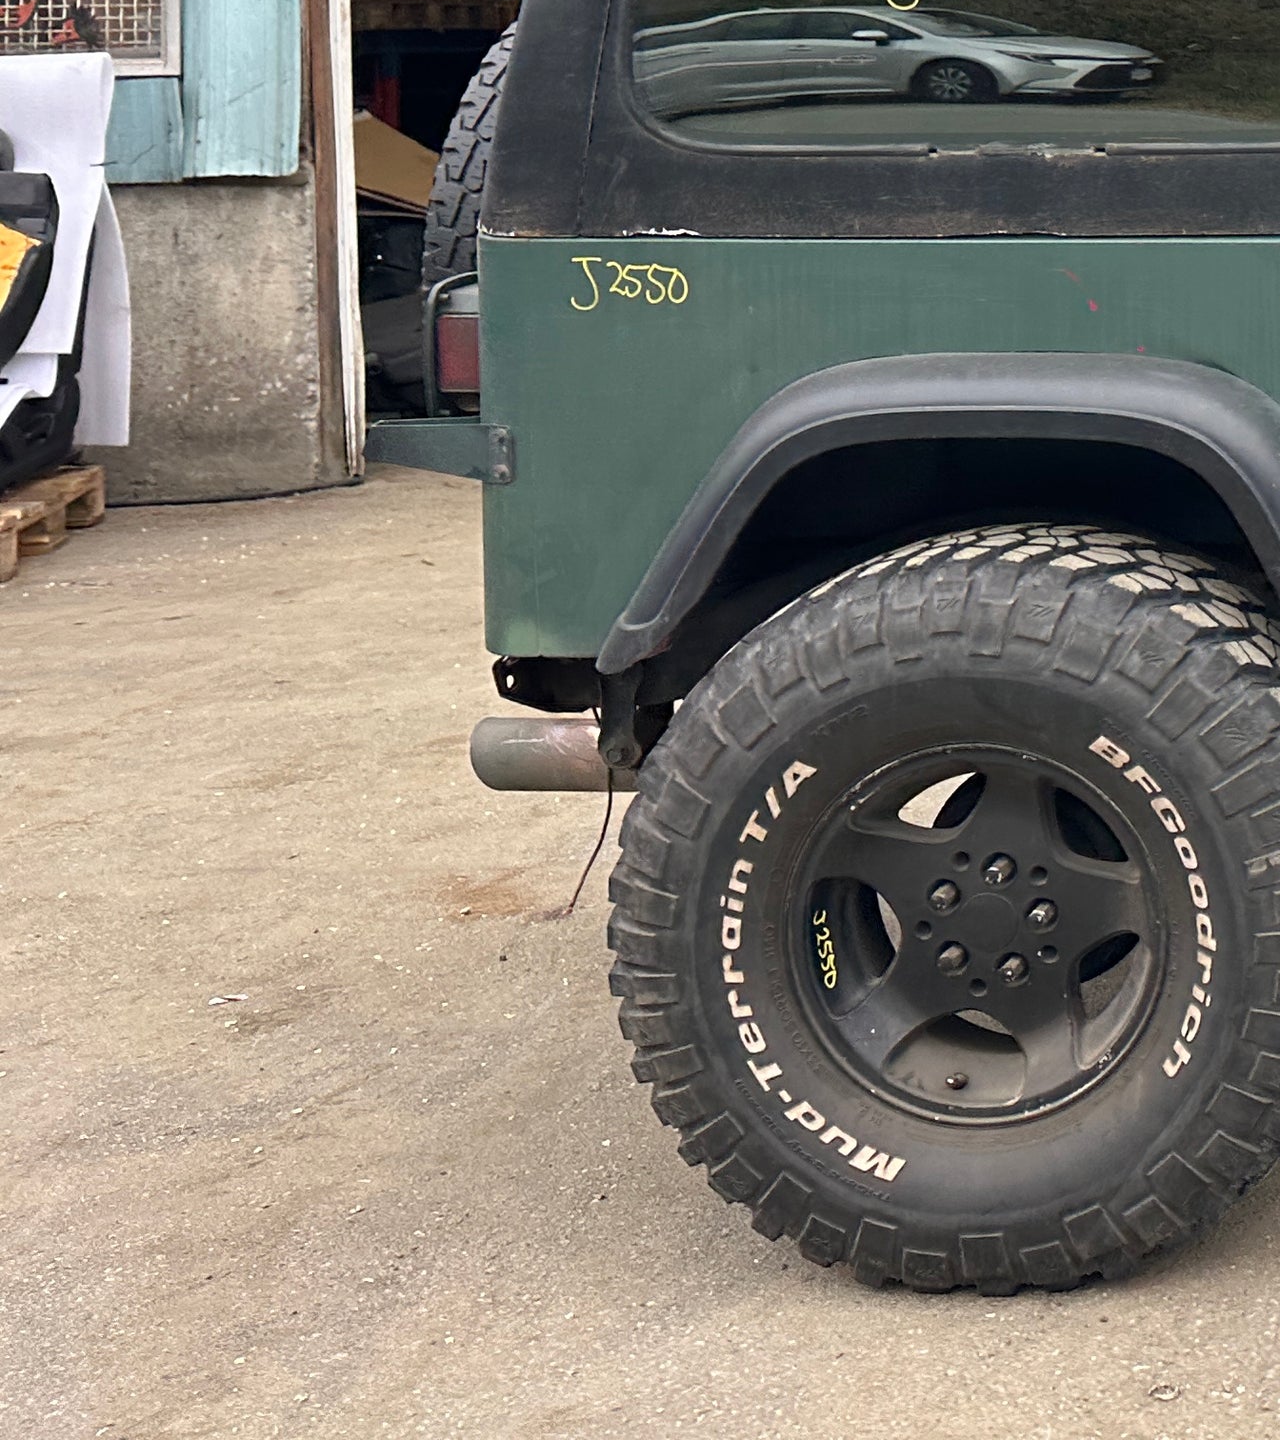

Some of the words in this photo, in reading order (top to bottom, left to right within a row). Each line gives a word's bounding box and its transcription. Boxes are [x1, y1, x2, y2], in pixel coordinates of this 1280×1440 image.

[570, 256, 690, 311] J2550
[739, 760, 818, 844] T/A
[1087, 734, 1218, 1079] BFGoodrich
